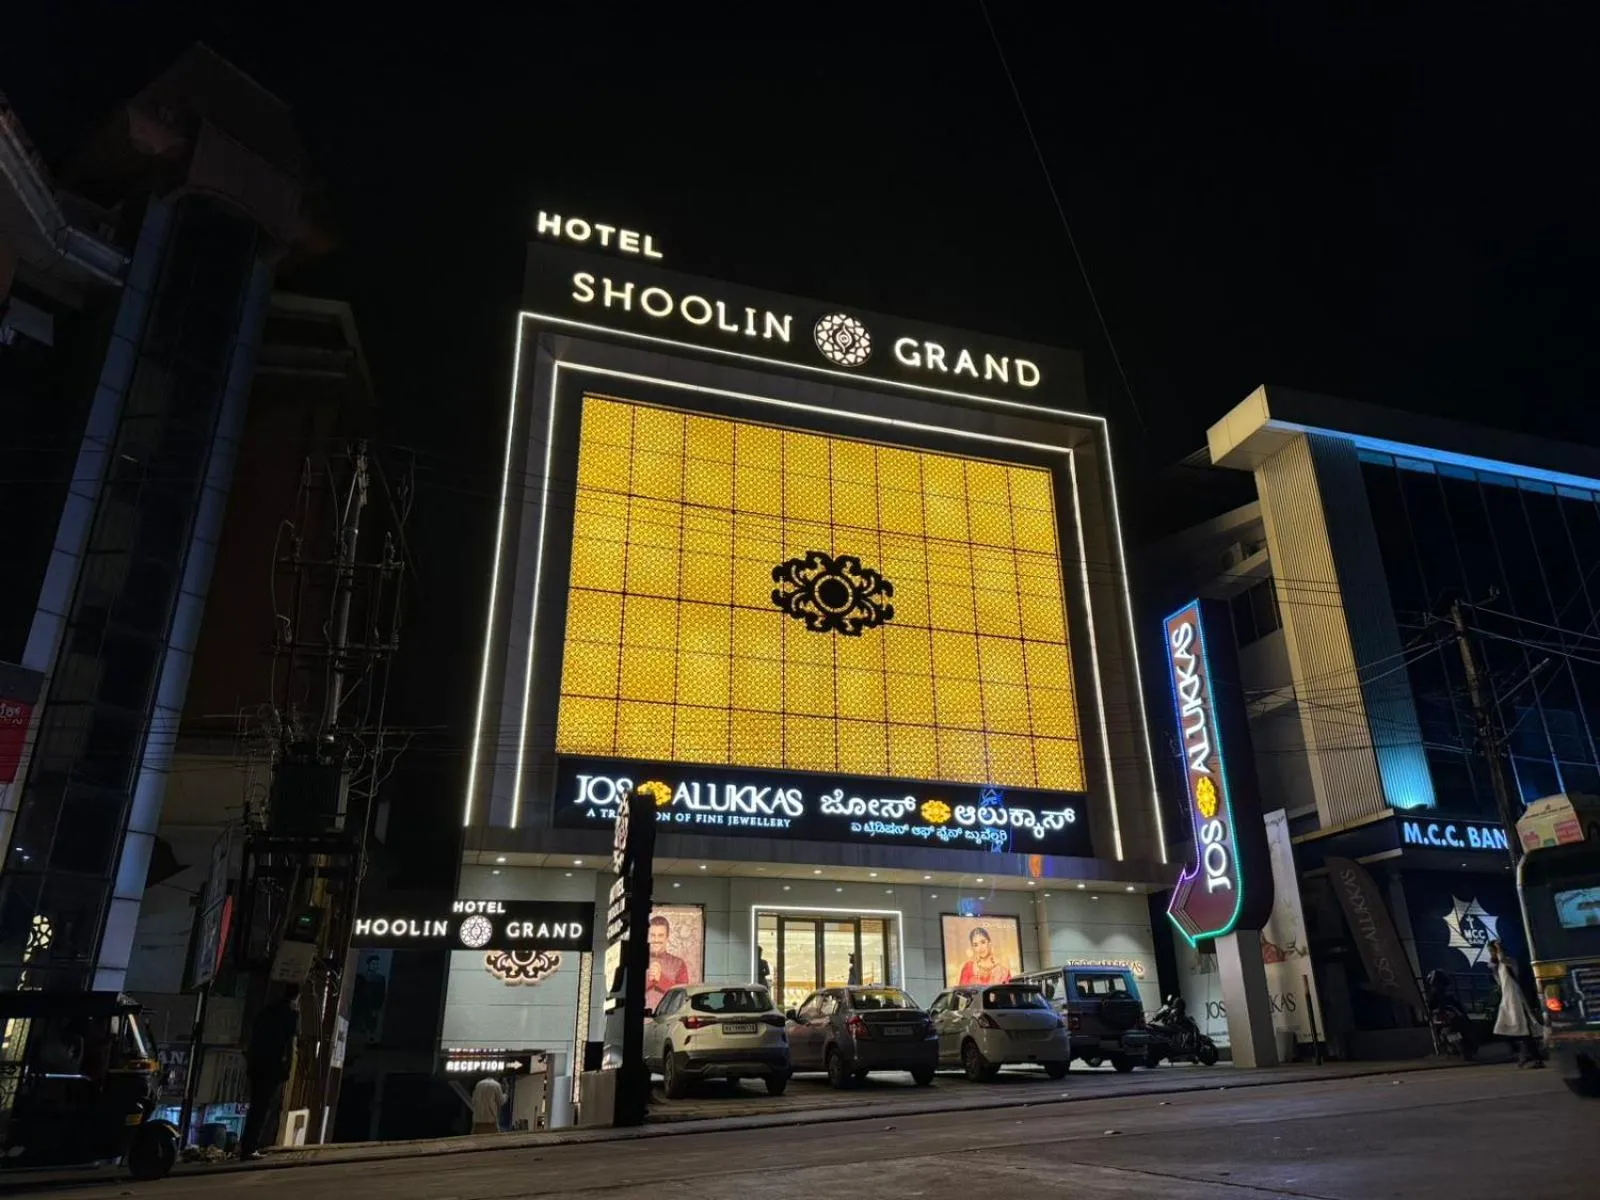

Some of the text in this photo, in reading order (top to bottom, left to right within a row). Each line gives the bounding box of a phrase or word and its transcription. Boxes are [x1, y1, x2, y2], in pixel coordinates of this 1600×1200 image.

[537, 211, 663, 258] HOTEL
[571, 271, 1041, 388] SHOOLIN GRAND
[1171, 622, 1210, 773] ALUKKAS
[671, 781, 804, 816] ALUKKAS
[819, 787, 1076, 839] ಜೋಸ್ ಆಲುಕ್ಕಾಸ್
[586, 808, 597, 818] A
[677, 811, 691, 823] OF
[695, 813, 724, 825] FINE
[727, 816, 792, 829] JEWELLERY
[1402, 821, 1509, 850] M.C.C. BAN
[1203, 819, 1232, 893] JOS
[452, 900, 506, 914] HOTEL
[355, 918, 584, 939] HOOLIN GRAND
[446, 1060, 505, 1071] RECEPTION
